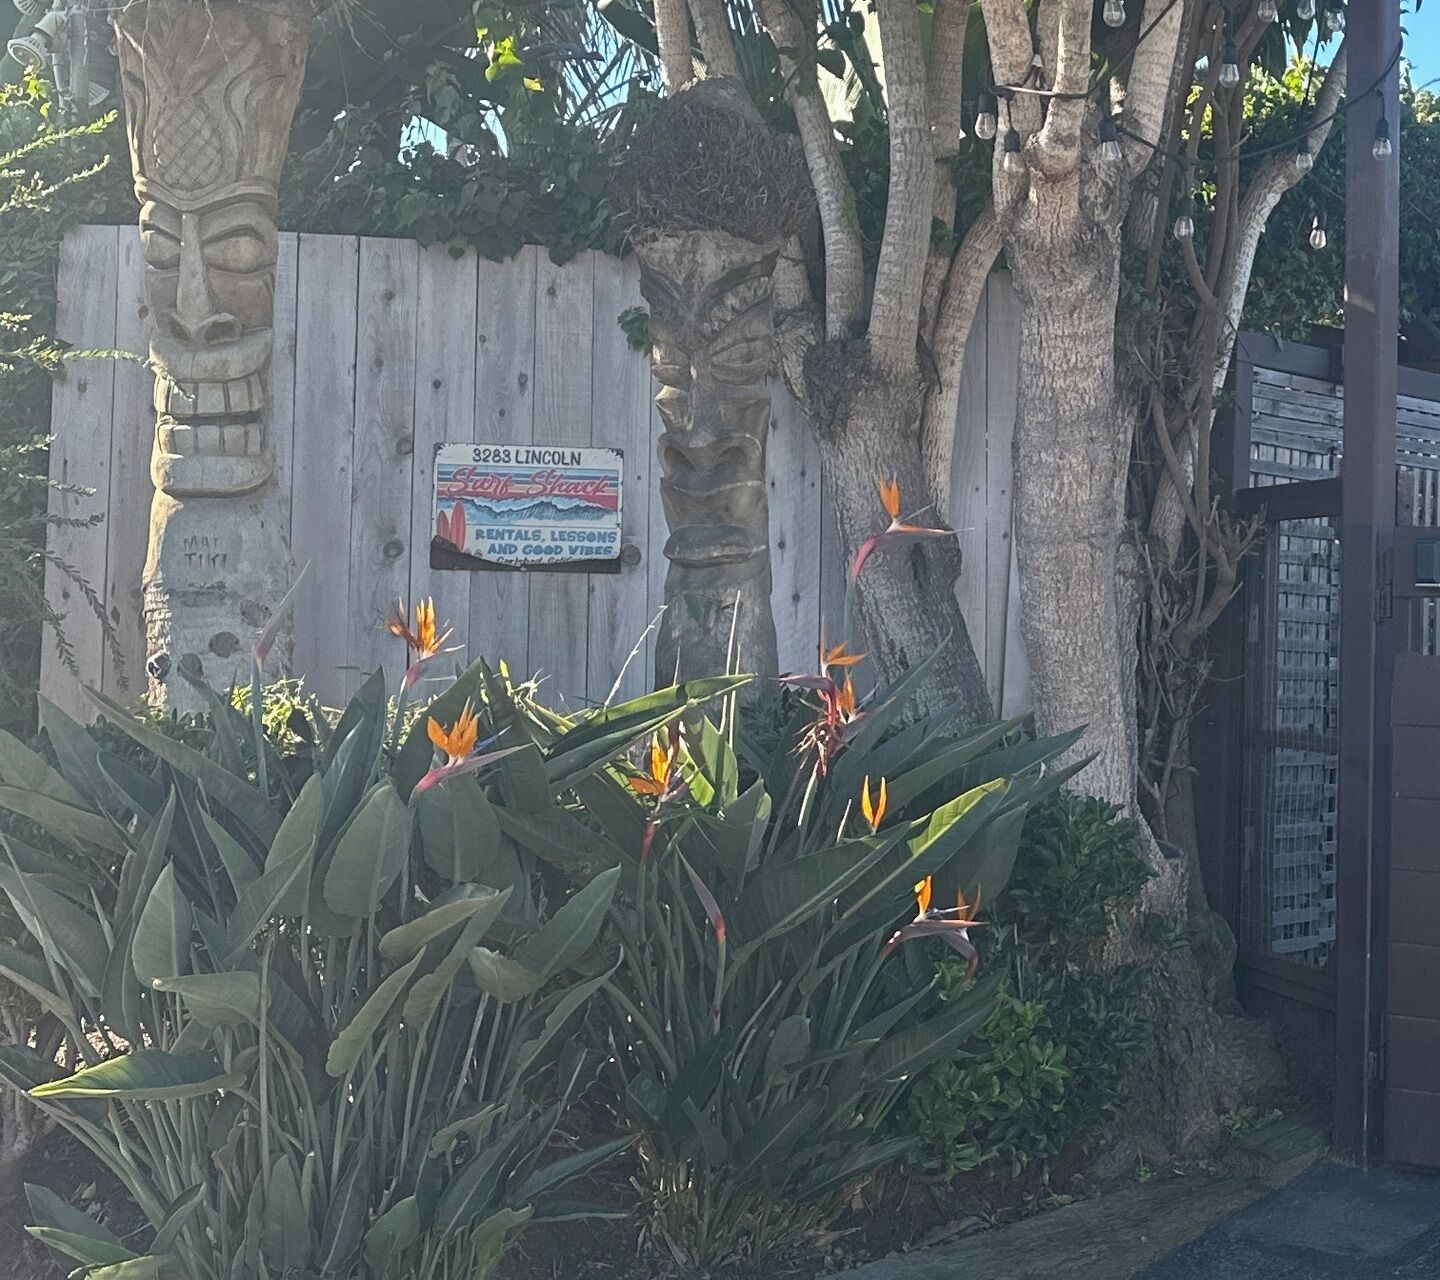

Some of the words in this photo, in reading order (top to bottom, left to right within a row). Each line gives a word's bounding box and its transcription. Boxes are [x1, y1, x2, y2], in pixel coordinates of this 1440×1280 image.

[472, 447, 512, 464] 3283
[515, 449, 581, 466] LINCOLN
[447, 466, 514, 498] Surf
[525, 469, 610, 496] Shack
[475, 528, 546, 543] RENTALS,
[551, 530, 618, 543] LESSONS
[487, 543, 518, 555] AND
[522, 544, 564, 556] GOOD
[568, 544, 614, 556] VIBES
